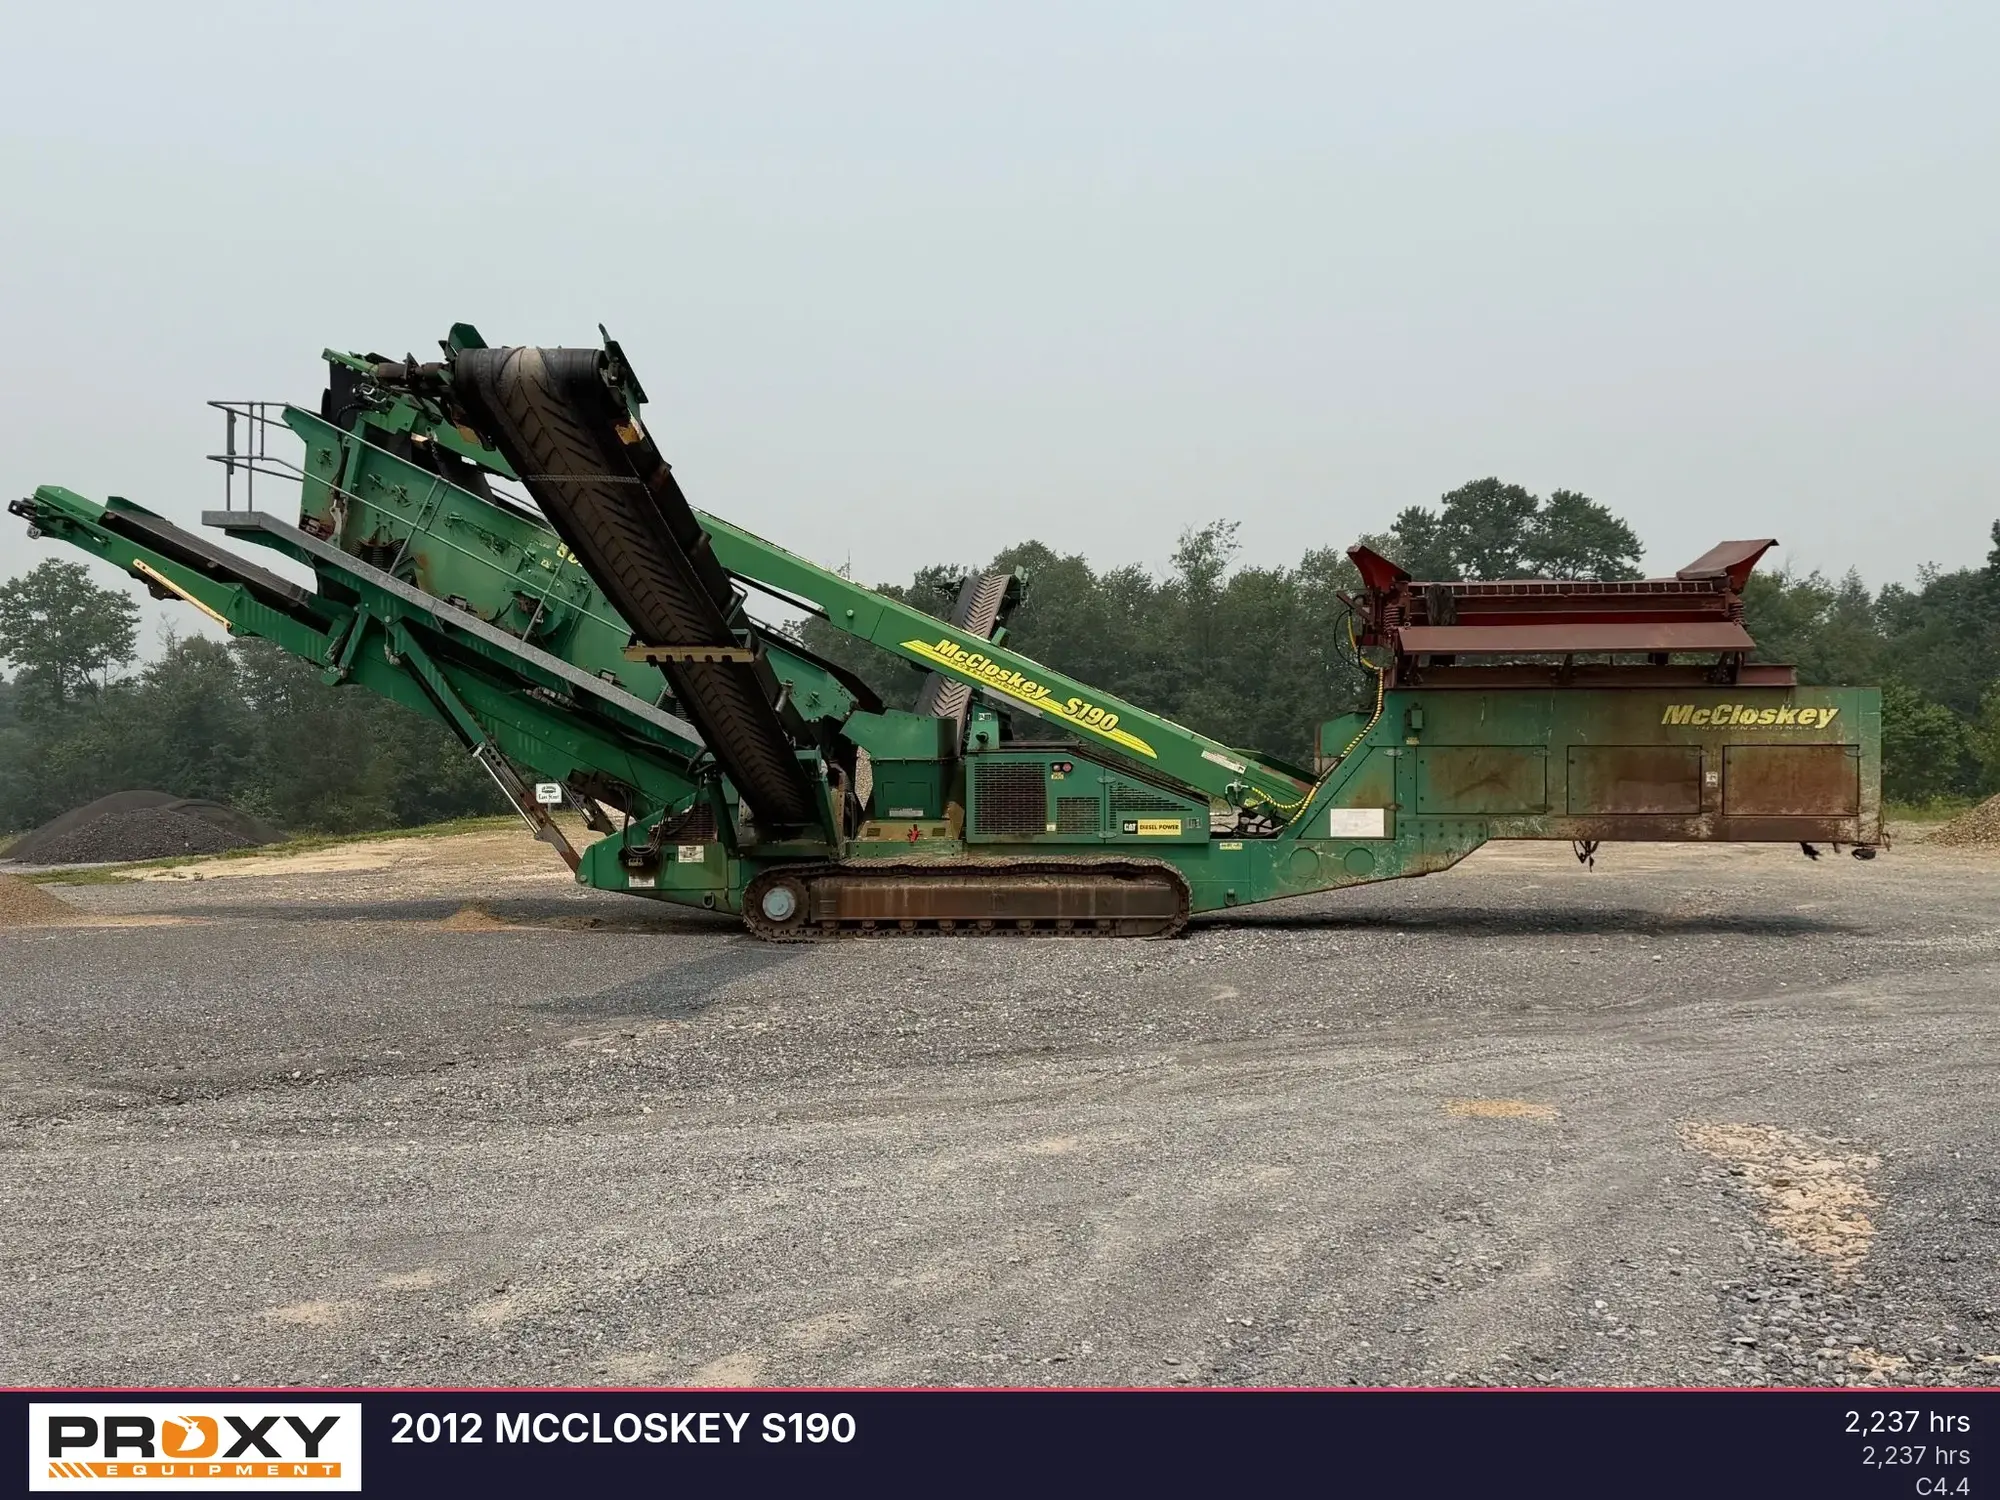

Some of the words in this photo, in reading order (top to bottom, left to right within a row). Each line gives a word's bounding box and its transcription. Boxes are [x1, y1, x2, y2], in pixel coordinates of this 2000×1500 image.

[933, 638, 1052, 700] McCloskey
[1061, 697, 1120, 732] S190
[1661, 704, 1841, 729] McCloskey
[1124, 823, 1136, 831] CAT
